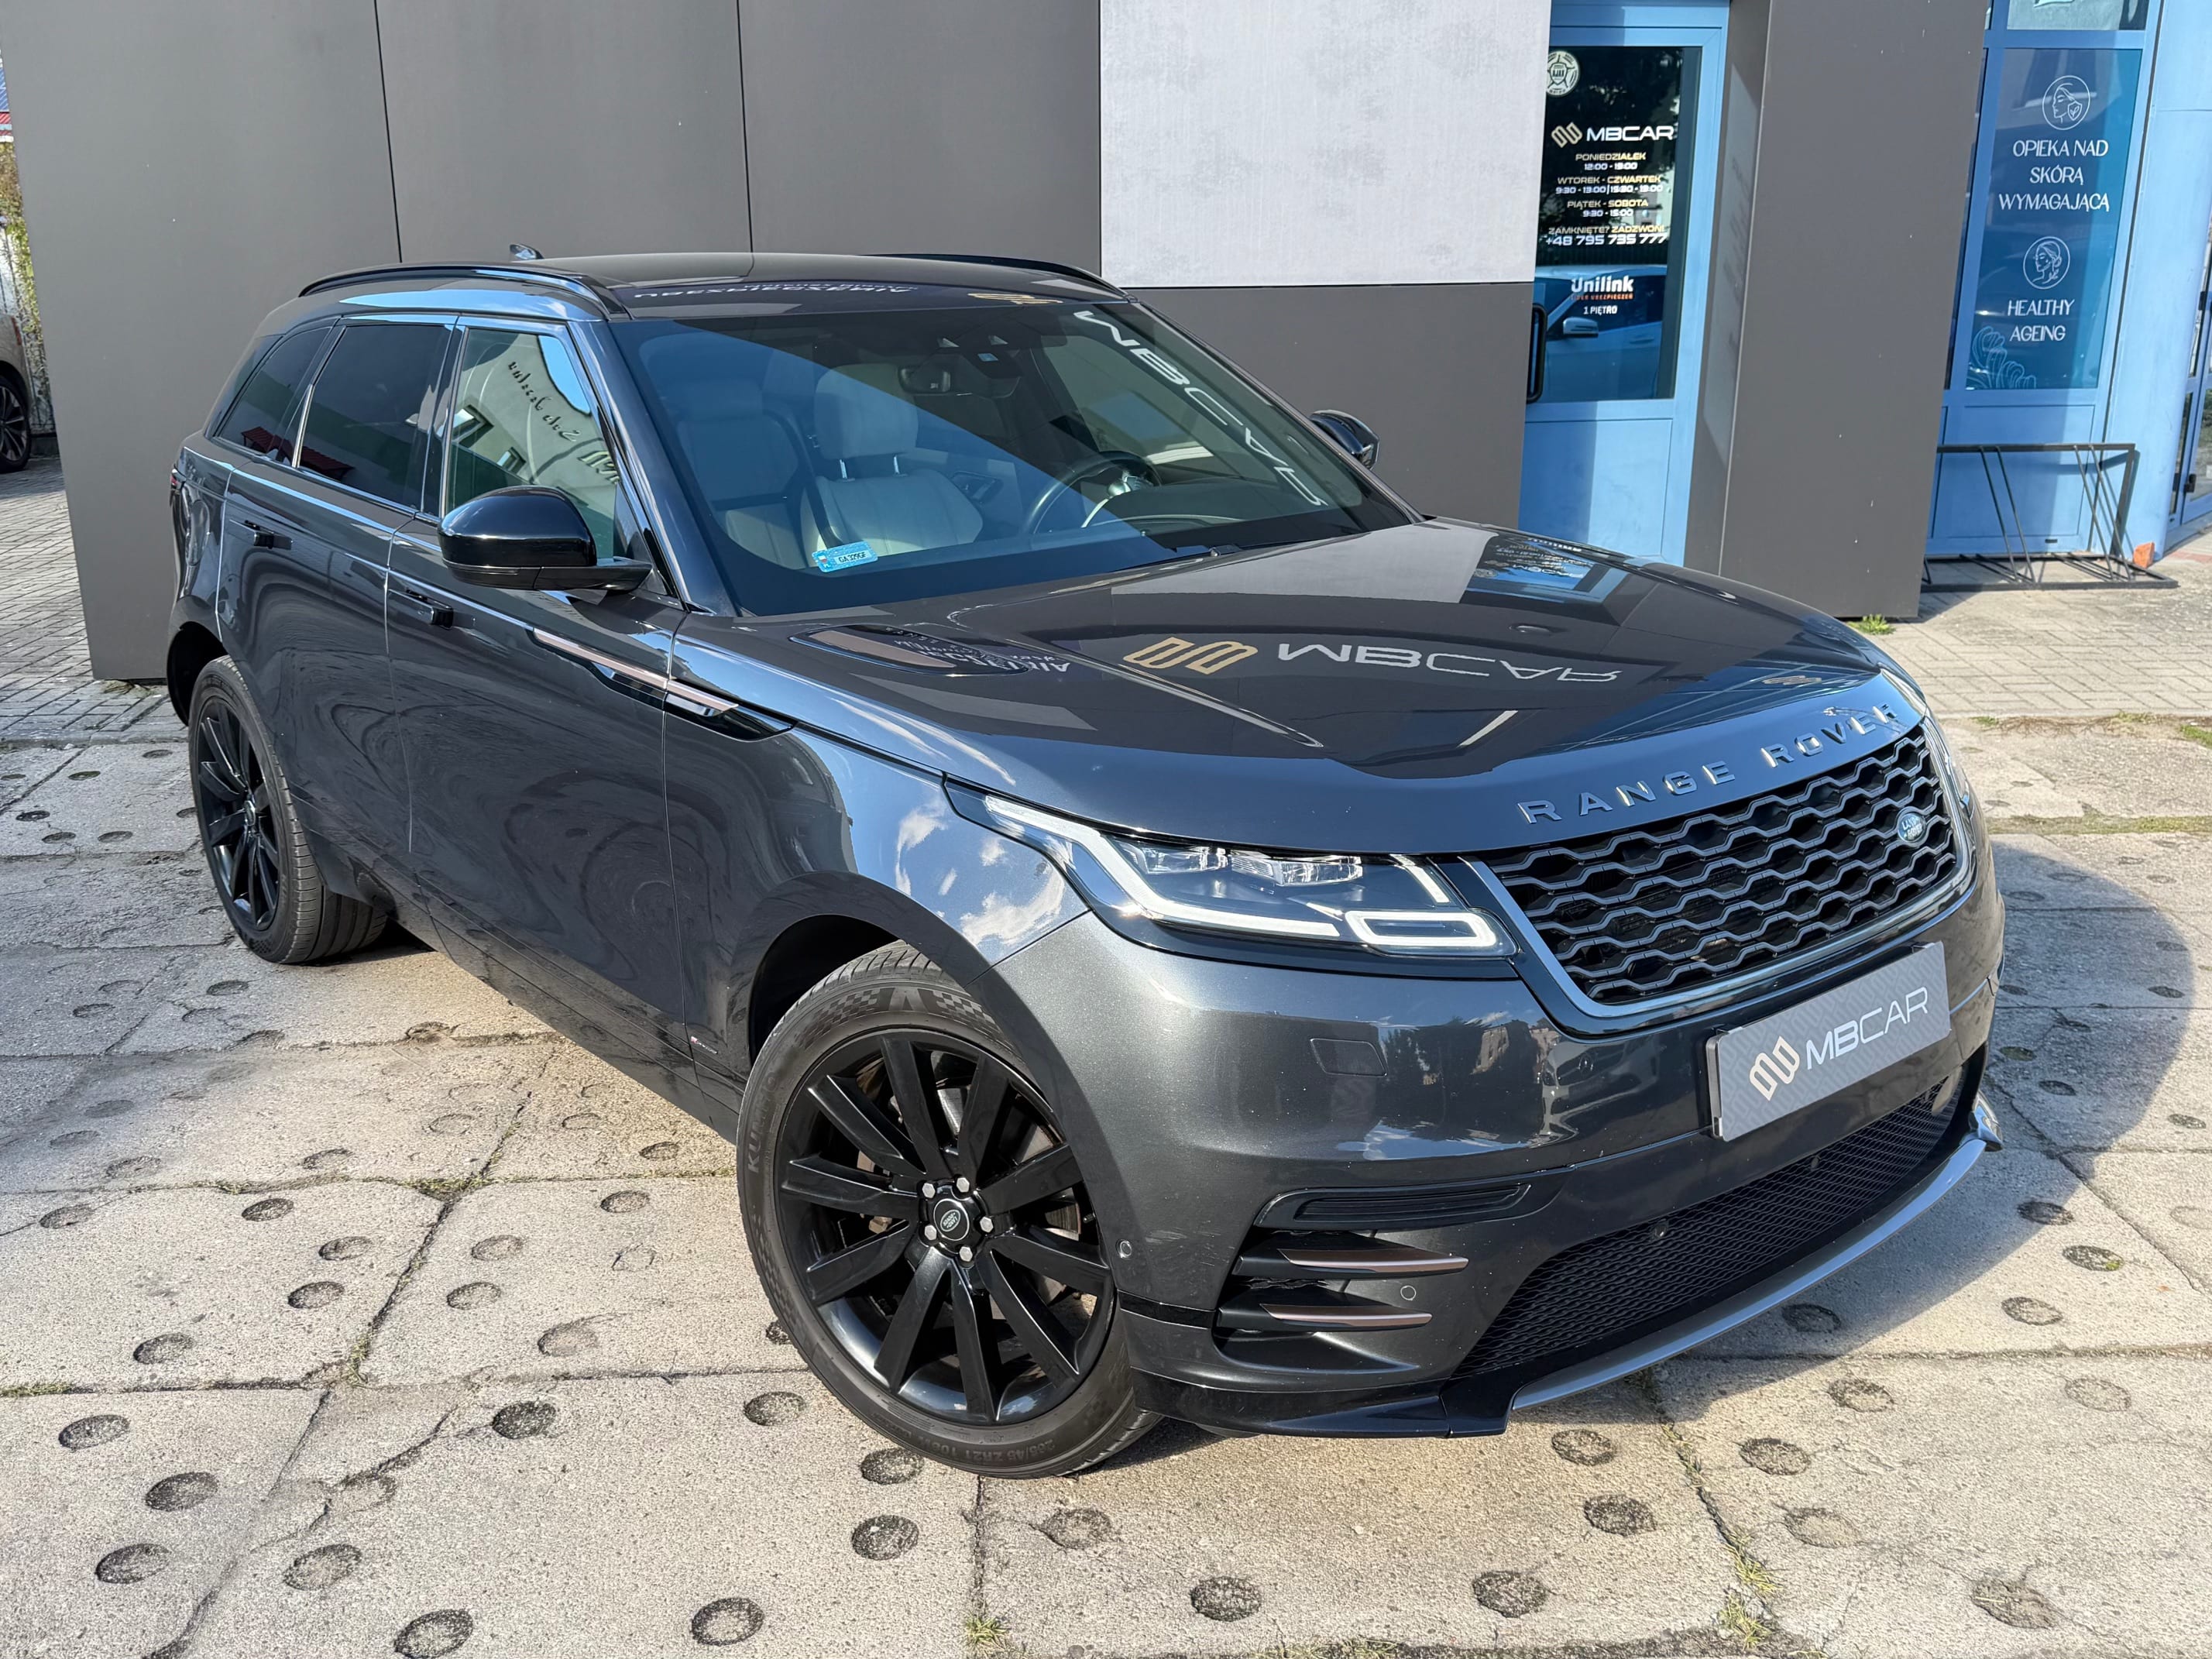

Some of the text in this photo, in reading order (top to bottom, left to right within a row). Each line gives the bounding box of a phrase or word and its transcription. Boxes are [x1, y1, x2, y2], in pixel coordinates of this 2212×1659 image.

[1586, 125, 1674, 142] MBCAR
[2012, 138, 2109, 157] OPIEKA NAD
[1575, 152, 1647, 161] PONIEDZIAŁEK
[1557, 176, 1600, 184] WTOREK
[1607, 175, 1661, 184] CZWARTEK
[2029, 163, 2084, 186] SKÓRĄ
[1567, 200, 1602, 210] PIĄTEK
[1608, 198, 1649, 208] SOBOTA
[1998, 193, 2111, 212] WYMAGAJĄCĄ
[1546, 233, 1668, 246] +48 795 735 777
[1571, 274, 1634, 293] Unilink
[1583, 304, 1618, 316] 1 PIĘTRO
[2007, 299, 2075, 317] HEALTHY
[2009, 325, 2066, 342] AGEING
[1516, 702, 1898, 824] RANGE ROVER
[1805, 986, 1929, 1070] MBCAR
